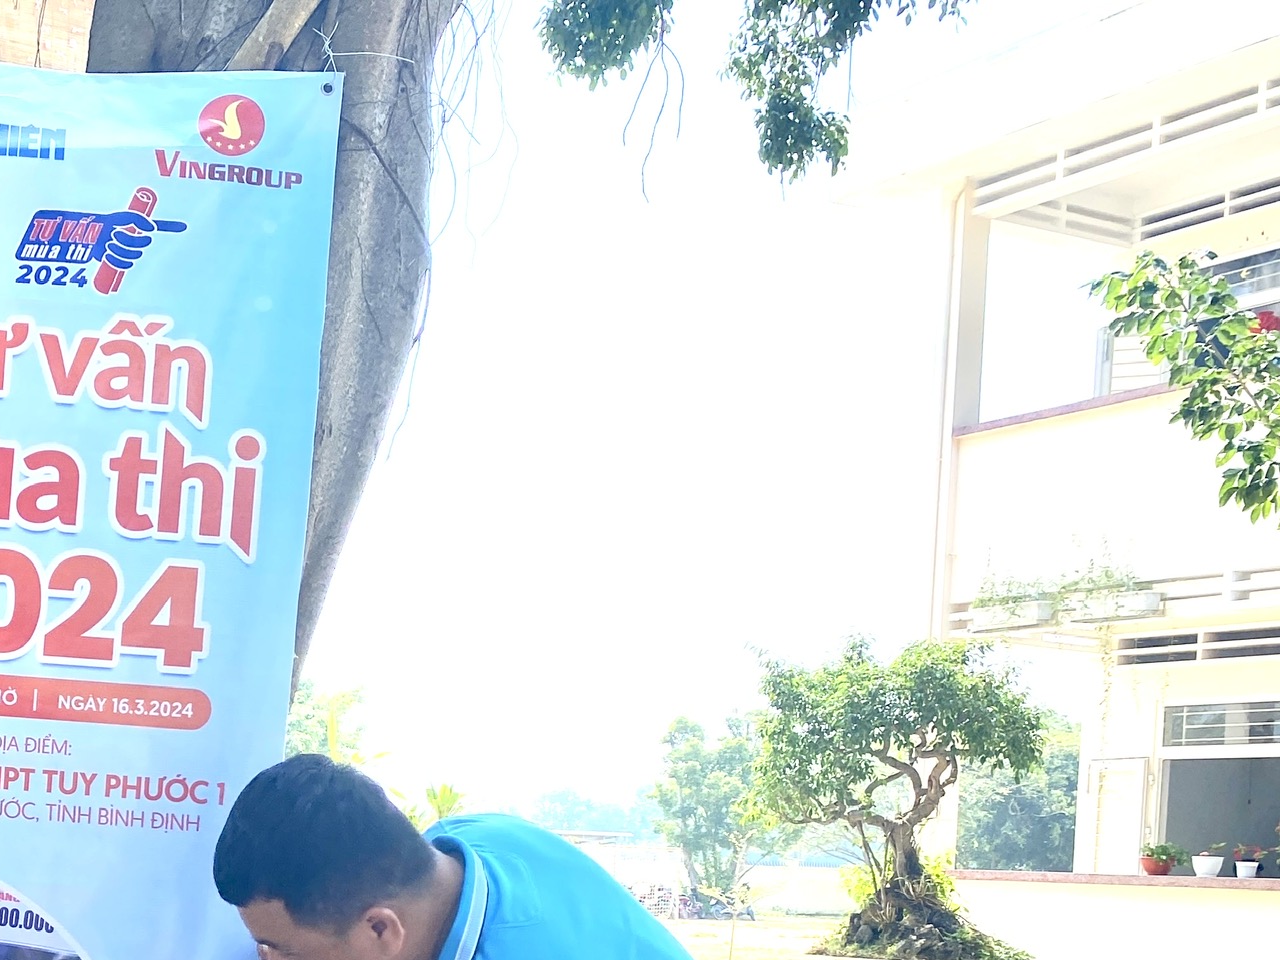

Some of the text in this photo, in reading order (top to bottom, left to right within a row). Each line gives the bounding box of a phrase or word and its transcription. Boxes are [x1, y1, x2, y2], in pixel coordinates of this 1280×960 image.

[29, 216, 104, 244] TƯ VẤN
[21, 242, 93, 261] mùa thi
[15, 264, 89, 288] 2024
[39, 319, 207, 424] vấn
[109, 426, 261, 558] thi
[58, 694, 107, 712] NGÀY
[112, 697, 194, 719] 16.3.2024
[24, 733, 72, 756] ĐIỂM:
[42, 769, 98, 796] TUY
[104, 774, 209, 805] PHƯỚC
[216, 782, 226, 806] 1
[45, 799, 92, 824] TỈNH
[98, 804, 145, 828] BÌNH
[151, 811, 201, 834] ĐỊNH
